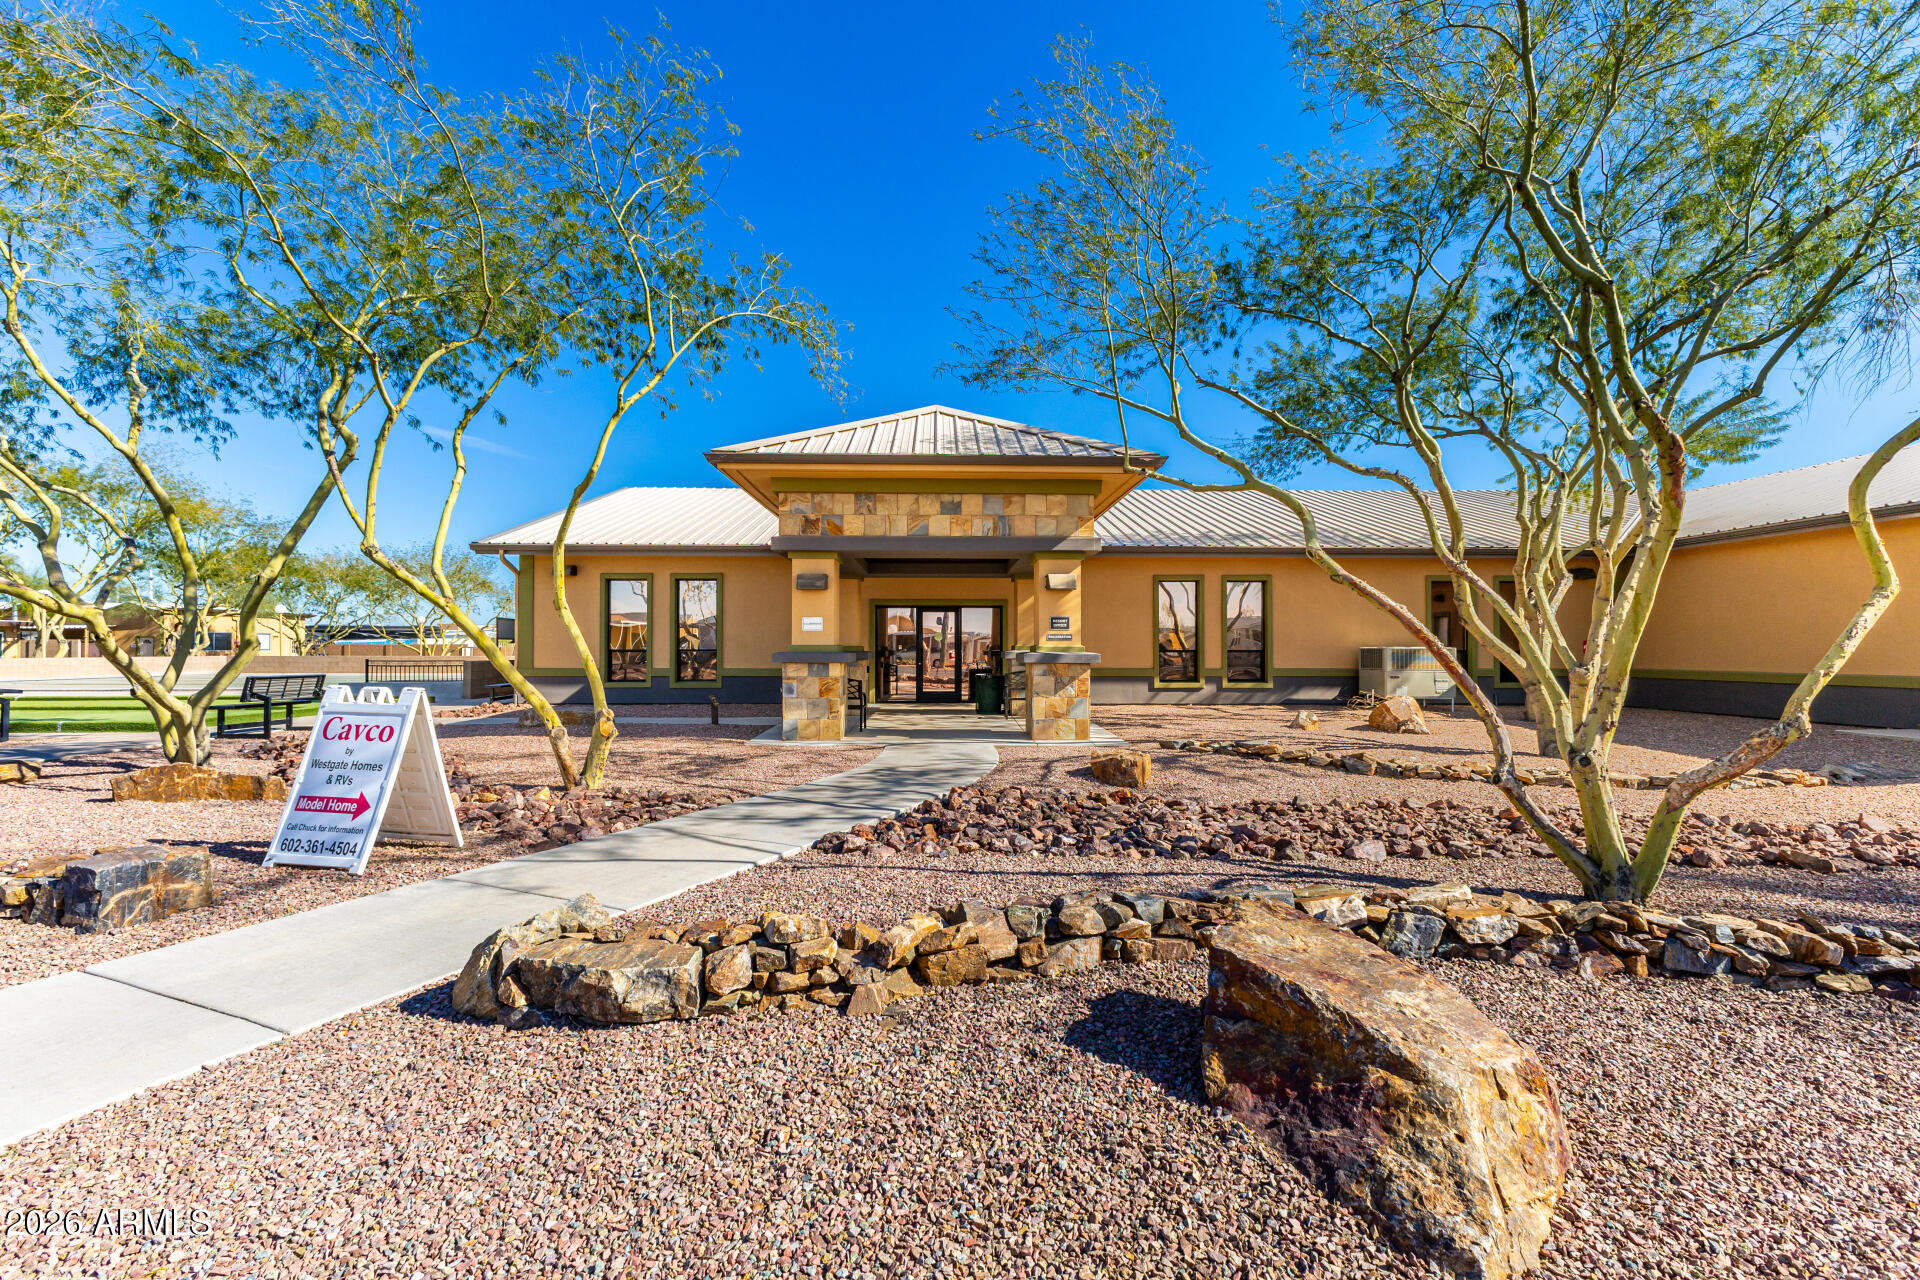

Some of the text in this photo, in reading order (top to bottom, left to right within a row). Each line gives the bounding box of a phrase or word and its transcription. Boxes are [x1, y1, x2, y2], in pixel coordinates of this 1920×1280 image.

[322, 716, 395, 743] Cavco
[344, 746, 354, 757] by
[311, 758, 383, 771] Westgate Homes
[326, 774, 353, 786] & RVs
[297, 797, 358, 812] Model Home
[286, 822, 298, 832] Call
[298, 823, 317, 832] Chuck
[327, 825, 364, 834] information
[280, 838, 359, 856] 602-361-4504
